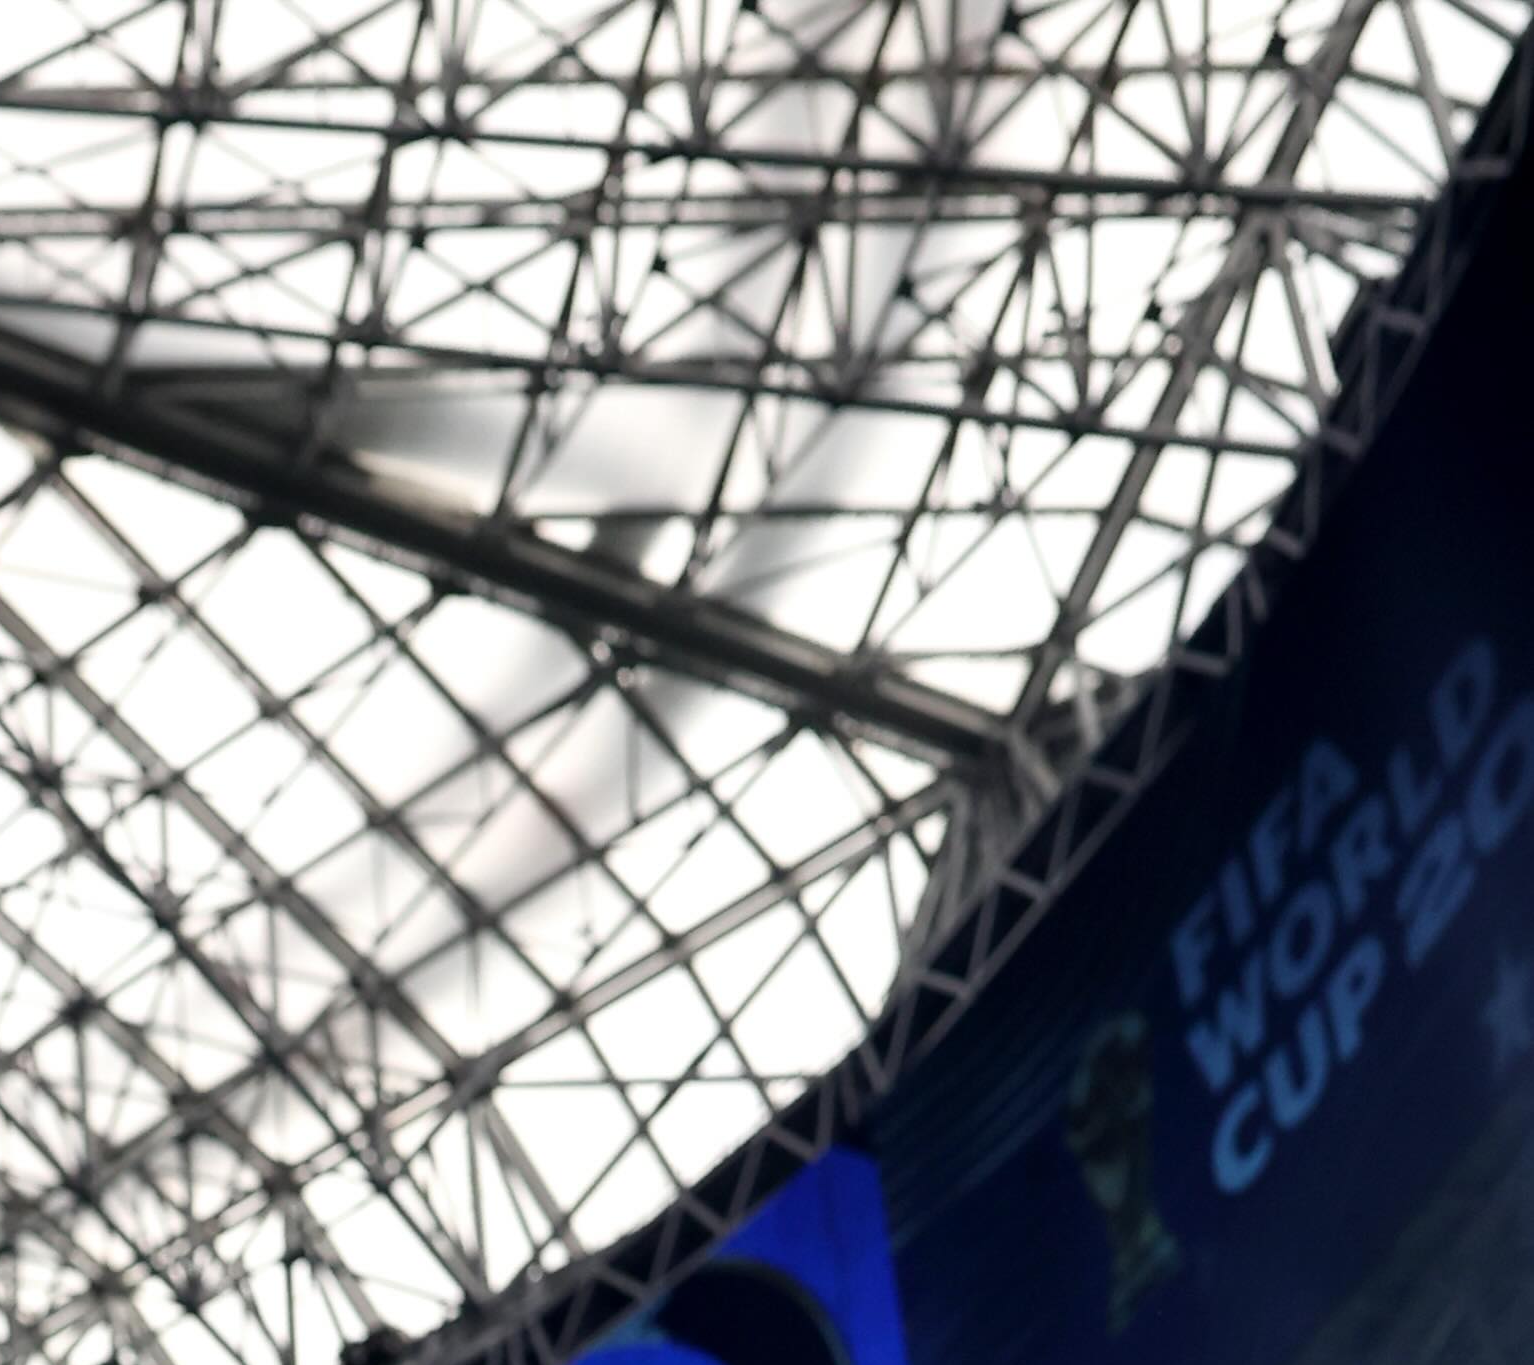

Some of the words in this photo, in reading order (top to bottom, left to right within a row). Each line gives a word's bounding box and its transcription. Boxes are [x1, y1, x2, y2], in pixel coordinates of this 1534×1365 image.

[1171, 734, 1358, 1009] FIFA
[1184, 635, 1496, 1095] WORLD
[1209, 934, 1387, 1194] CUP
[1395, 689, 1534, 970] 20
